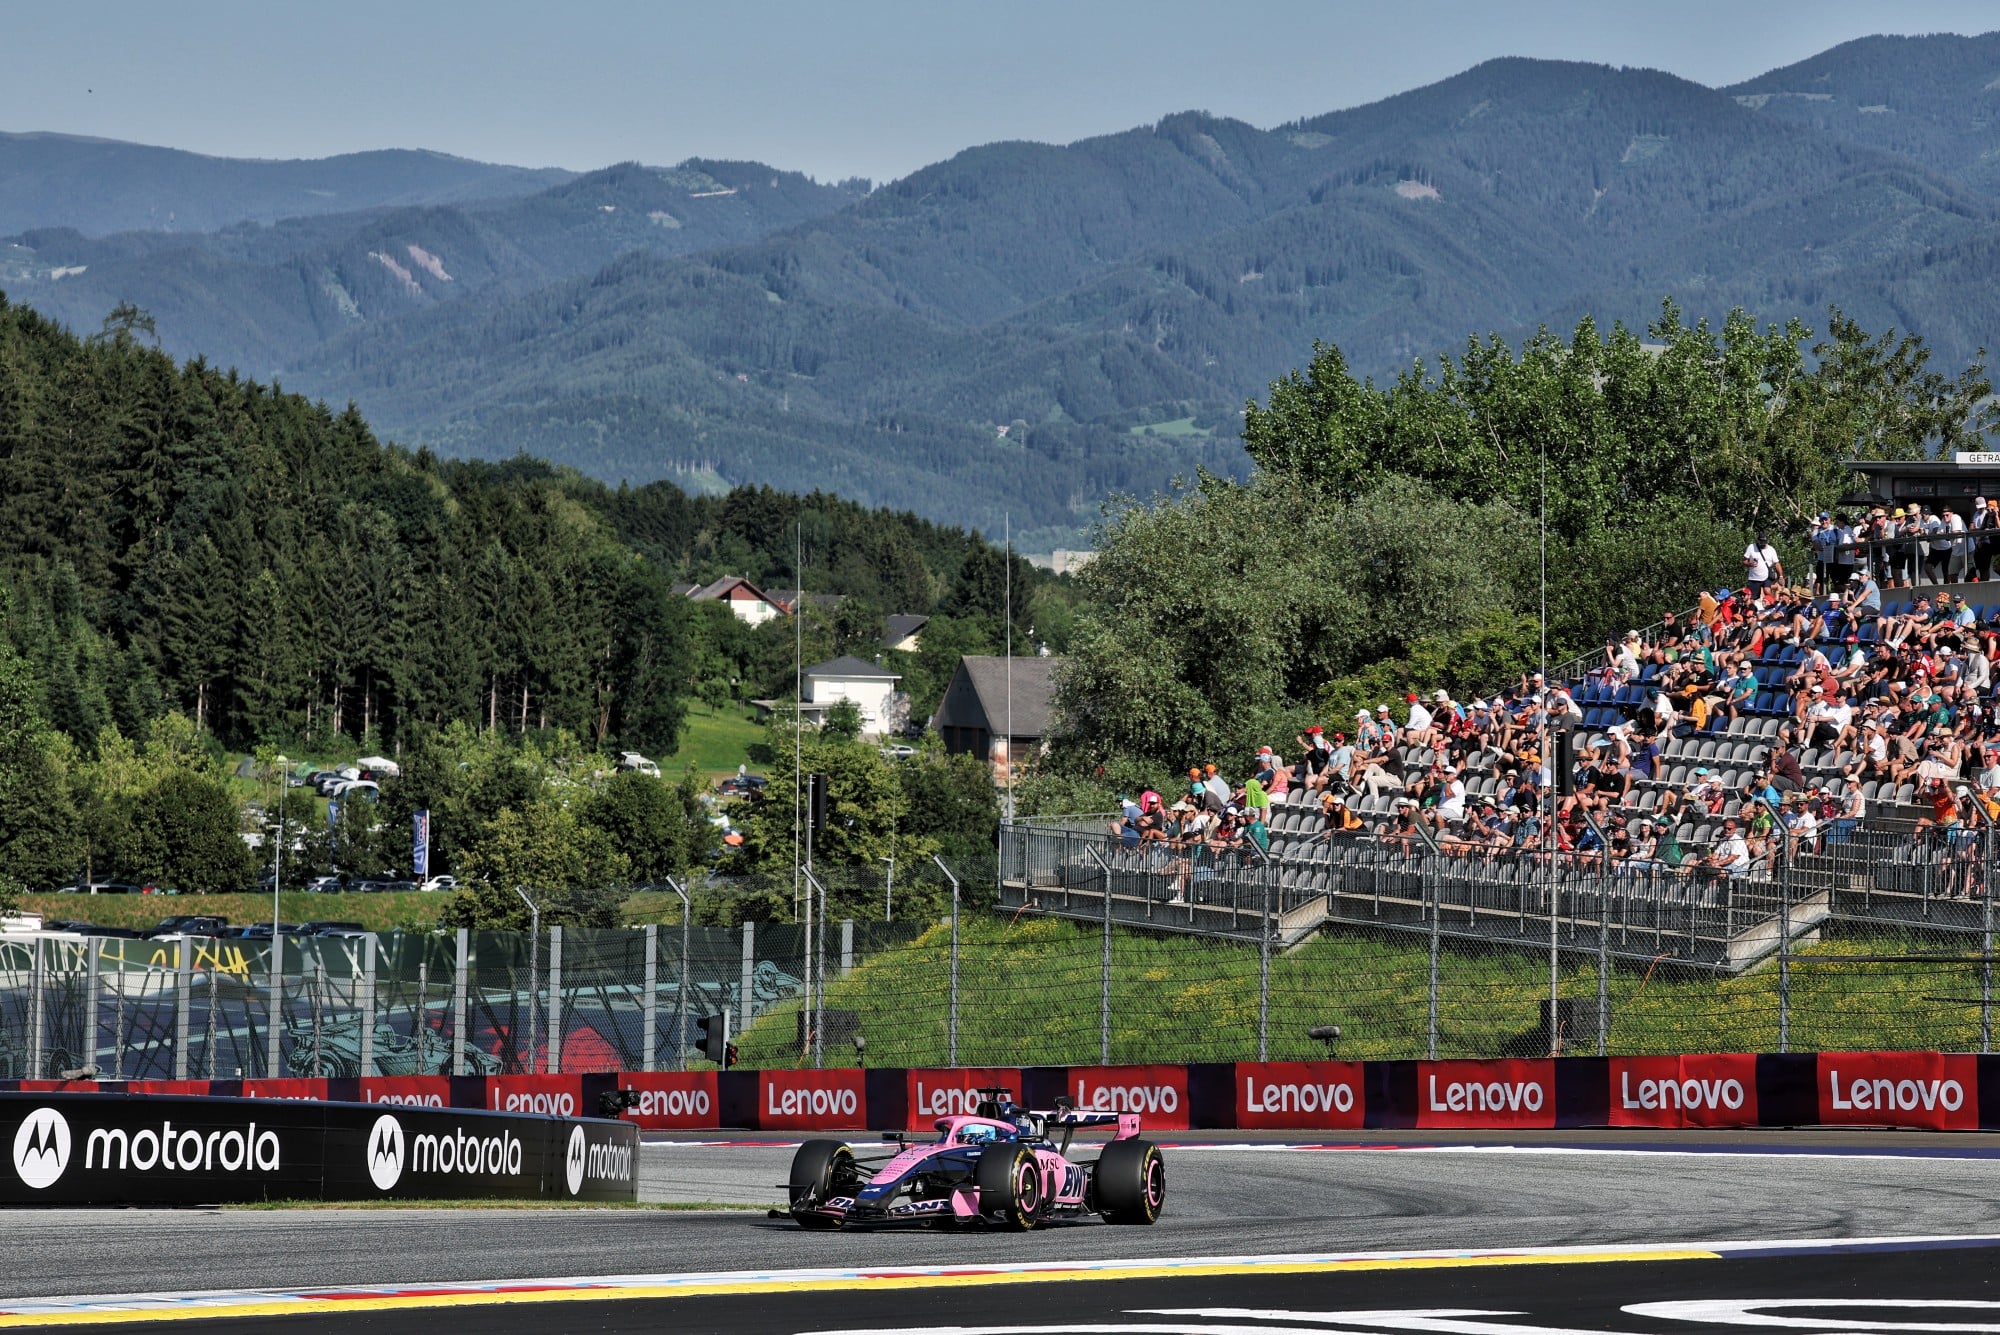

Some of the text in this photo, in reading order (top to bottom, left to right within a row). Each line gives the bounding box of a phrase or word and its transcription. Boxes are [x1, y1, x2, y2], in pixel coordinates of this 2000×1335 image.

[627, 1084, 709, 1116] Lenovo
[768, 1083, 857, 1116] Lenovo
[1078, 1080, 1178, 1113] Lenovo
[1247, 1077, 1354, 1113] Lenovo
[1429, 1075, 1544, 1112] Lenovo
[1621, 1071, 1744, 1110] Lenovo
[1830, 1070, 1964, 1111] Lenovo
[85, 1121, 280, 1171] motorola
[412, 1127, 522, 1175] motorola
[587, 1136, 632, 1182] motorola
[1040, 1157, 1060, 1171] MSC
